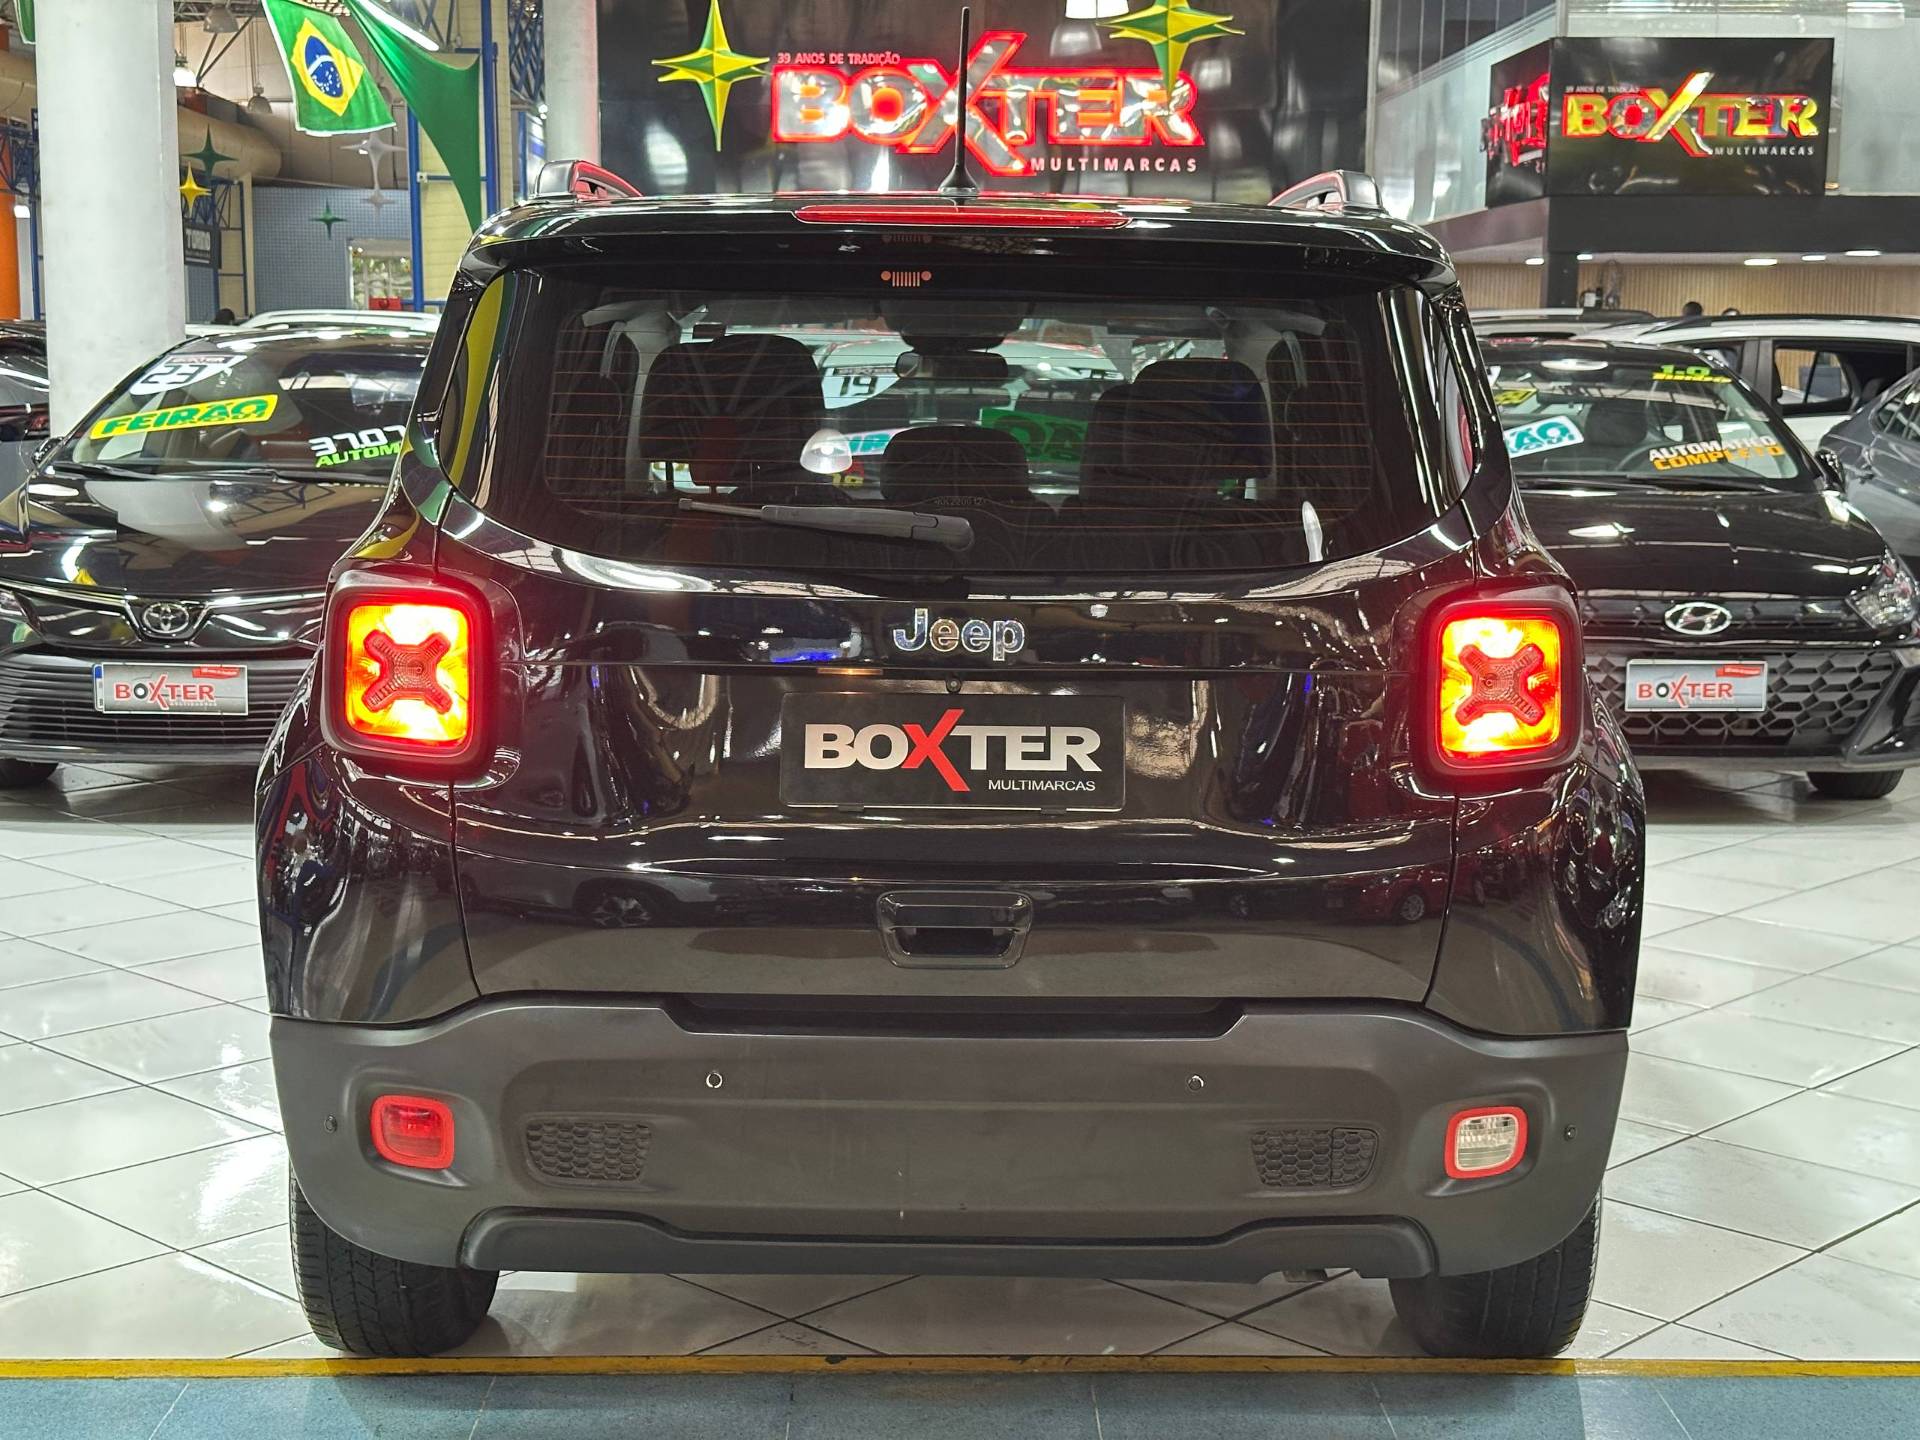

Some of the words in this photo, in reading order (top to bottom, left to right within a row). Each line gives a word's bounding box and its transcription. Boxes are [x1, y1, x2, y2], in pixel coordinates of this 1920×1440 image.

[777, 52, 791, 65] 39
[795, 52, 826, 65] ANOS
[829, 53, 844, 65] DE
[848, 51, 900, 66] TRADIÇÃO
[771, 31, 1205, 177] BOXTER
[1562, 70, 1819, 157] BOXTER
[1031, 157, 1198, 173] MULTIMARCAS
[1714, 145, 1816, 157] MULTIMARCAS
[140, 364, 208, 385] 23
[101, 399, 268, 435] FEIRÃO
[1653, 445, 1785, 472] COMPLETO
[892, 607, 1026, 662] Jeep
[114, 673, 216, 710] BOXTER
[1637, 672, 1734, 708] BOXTER
[803, 708, 1103, 792] BOXTER
[987, 778, 1097, 792] MULTIMARCAS
